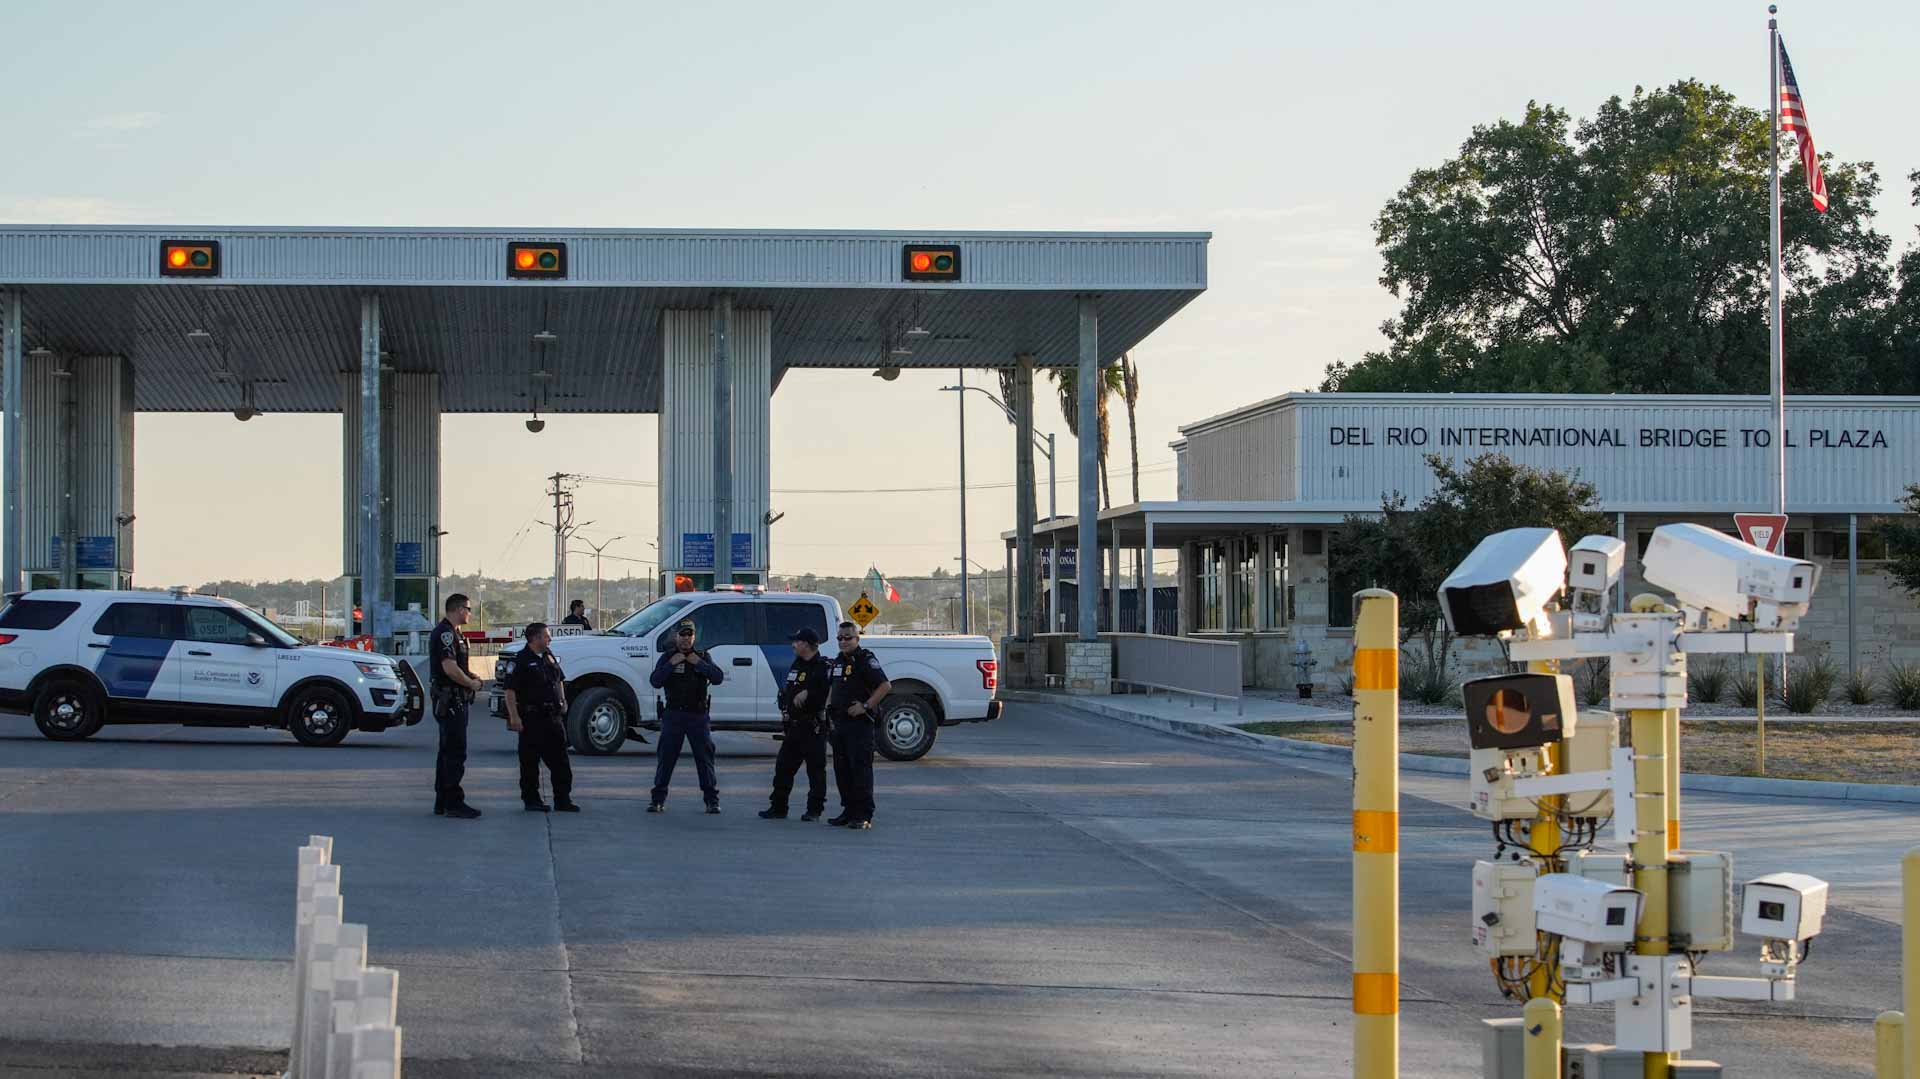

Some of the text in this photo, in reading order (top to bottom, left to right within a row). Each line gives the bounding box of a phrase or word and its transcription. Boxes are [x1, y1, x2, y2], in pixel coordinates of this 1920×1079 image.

[1330, 427, 1889, 448] DEL RIO INTERNATIONAL BRIDGE TOL PLAZA
[1754, 530, 1770, 539] YIELD
[551, 628, 582, 638] LOSED
